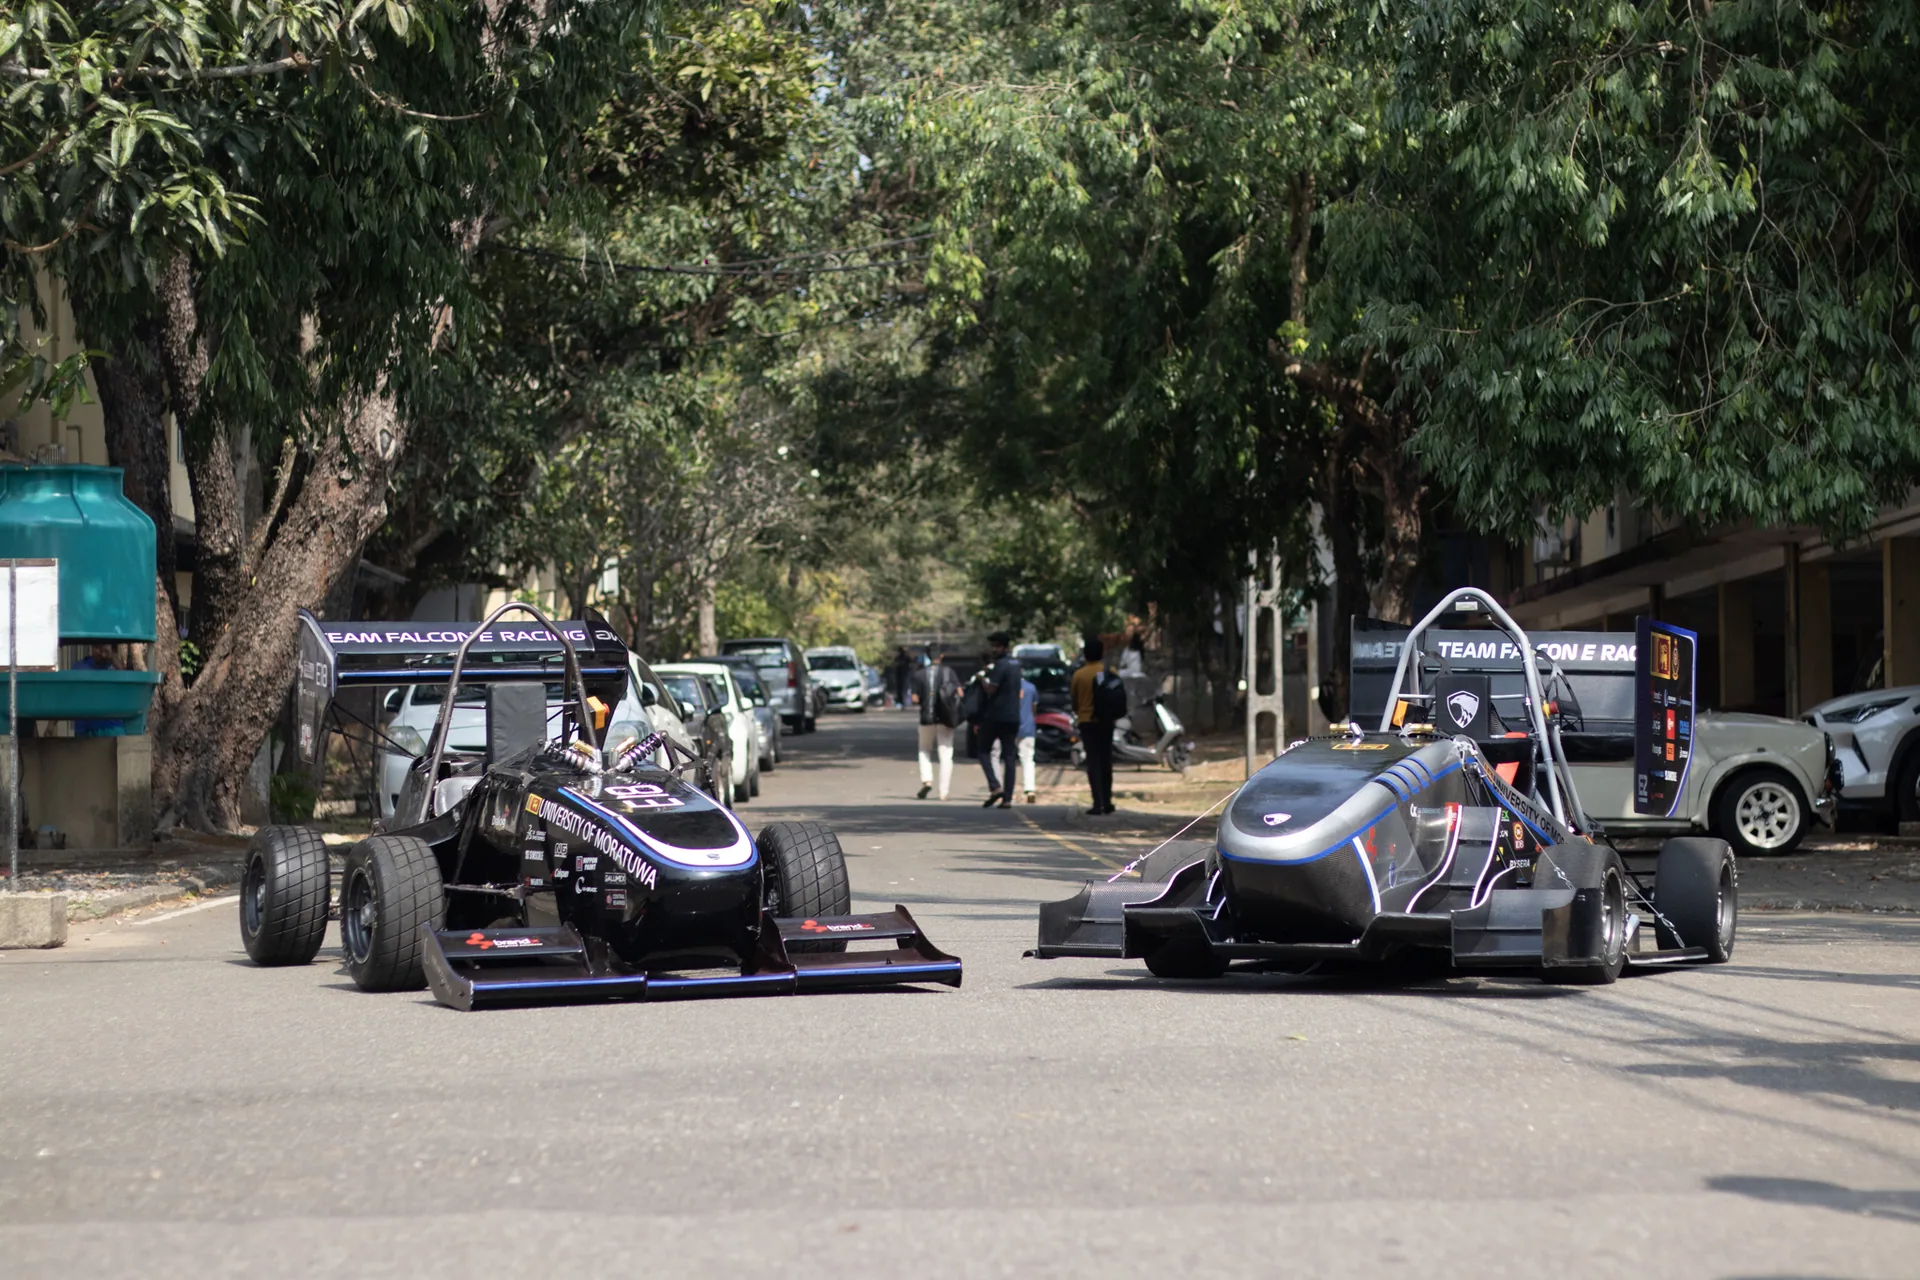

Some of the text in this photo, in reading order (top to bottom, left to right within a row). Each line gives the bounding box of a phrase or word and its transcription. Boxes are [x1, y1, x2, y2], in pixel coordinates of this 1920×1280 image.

[325, 632, 382, 643] EAM
[480, 631, 493, 642] E
[1438, 641, 1496, 659] TEAM
[1500, 642, 1578, 661] FACON
[1580, 644, 1597, 660] E
[1493, 776, 1539, 824] UNIVERSITY
[1540, 817, 1551, 832] OF
[538, 798, 657, 891] UNIVERSITY OF MORATUWA
